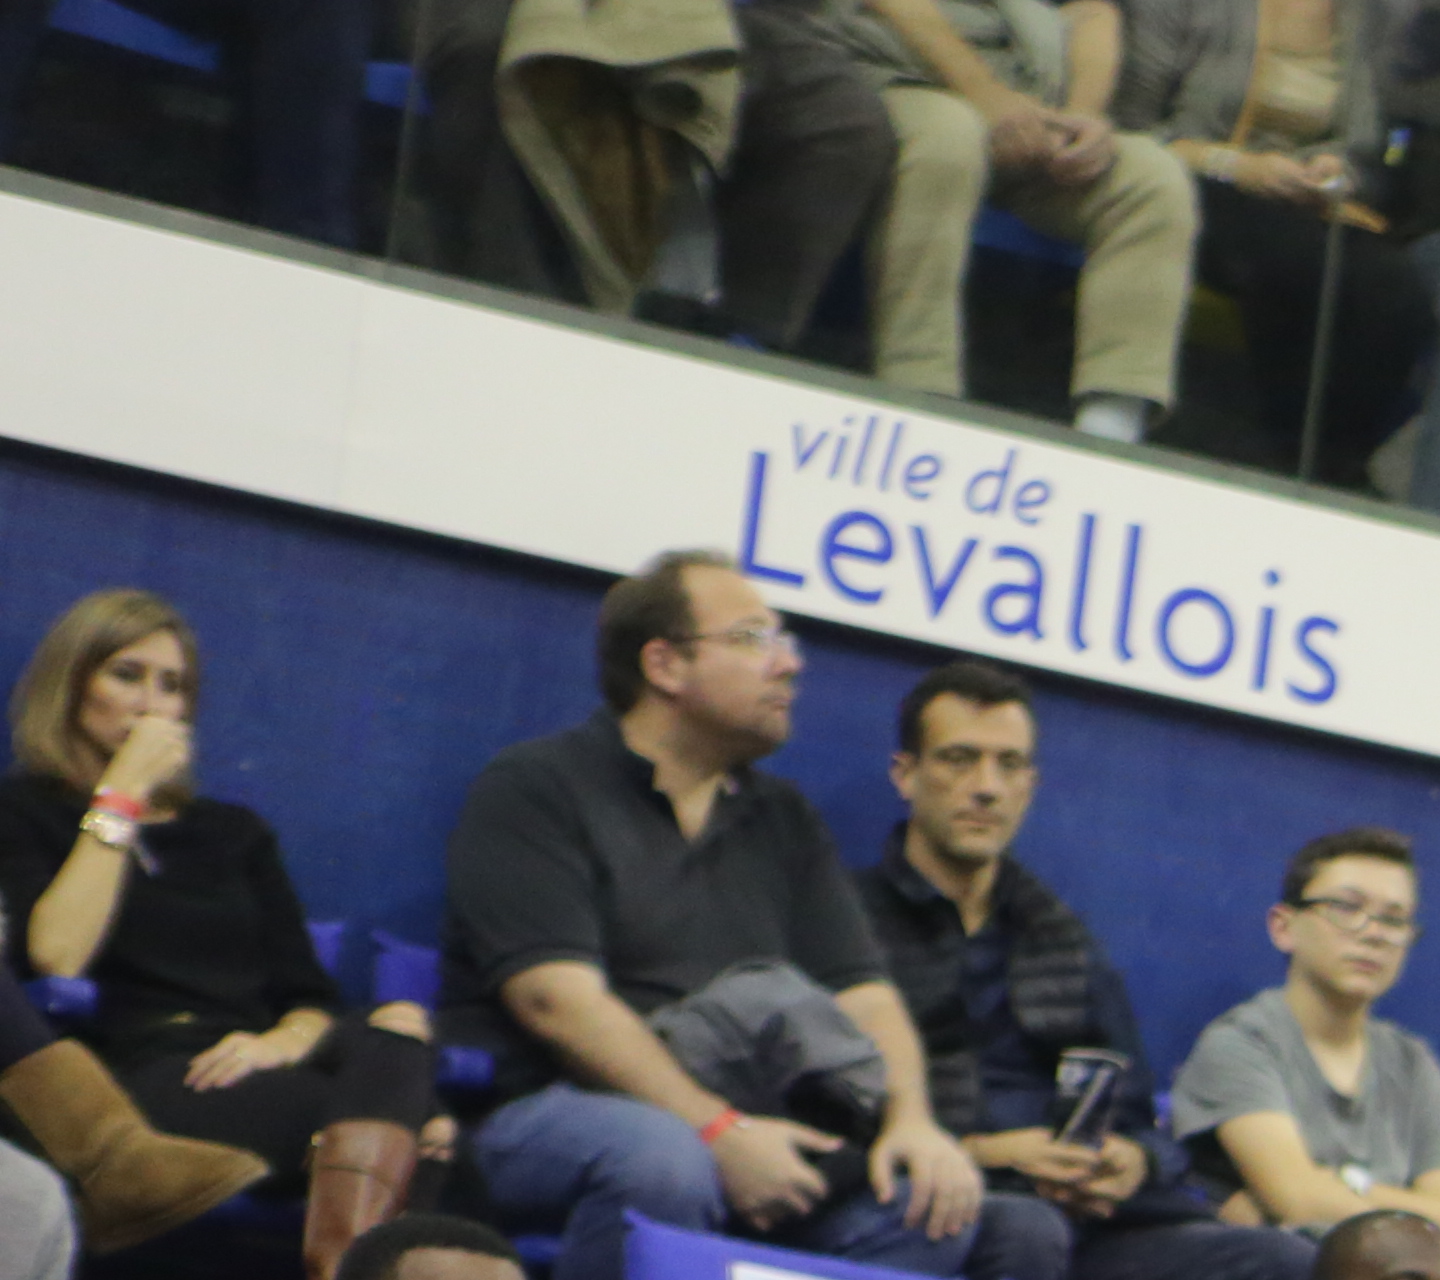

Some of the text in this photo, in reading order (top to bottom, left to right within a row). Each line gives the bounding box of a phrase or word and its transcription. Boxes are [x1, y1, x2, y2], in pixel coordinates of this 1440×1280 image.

[790, 411, 1054, 525] ville de
[738, 450, 1342, 706] Levallois
